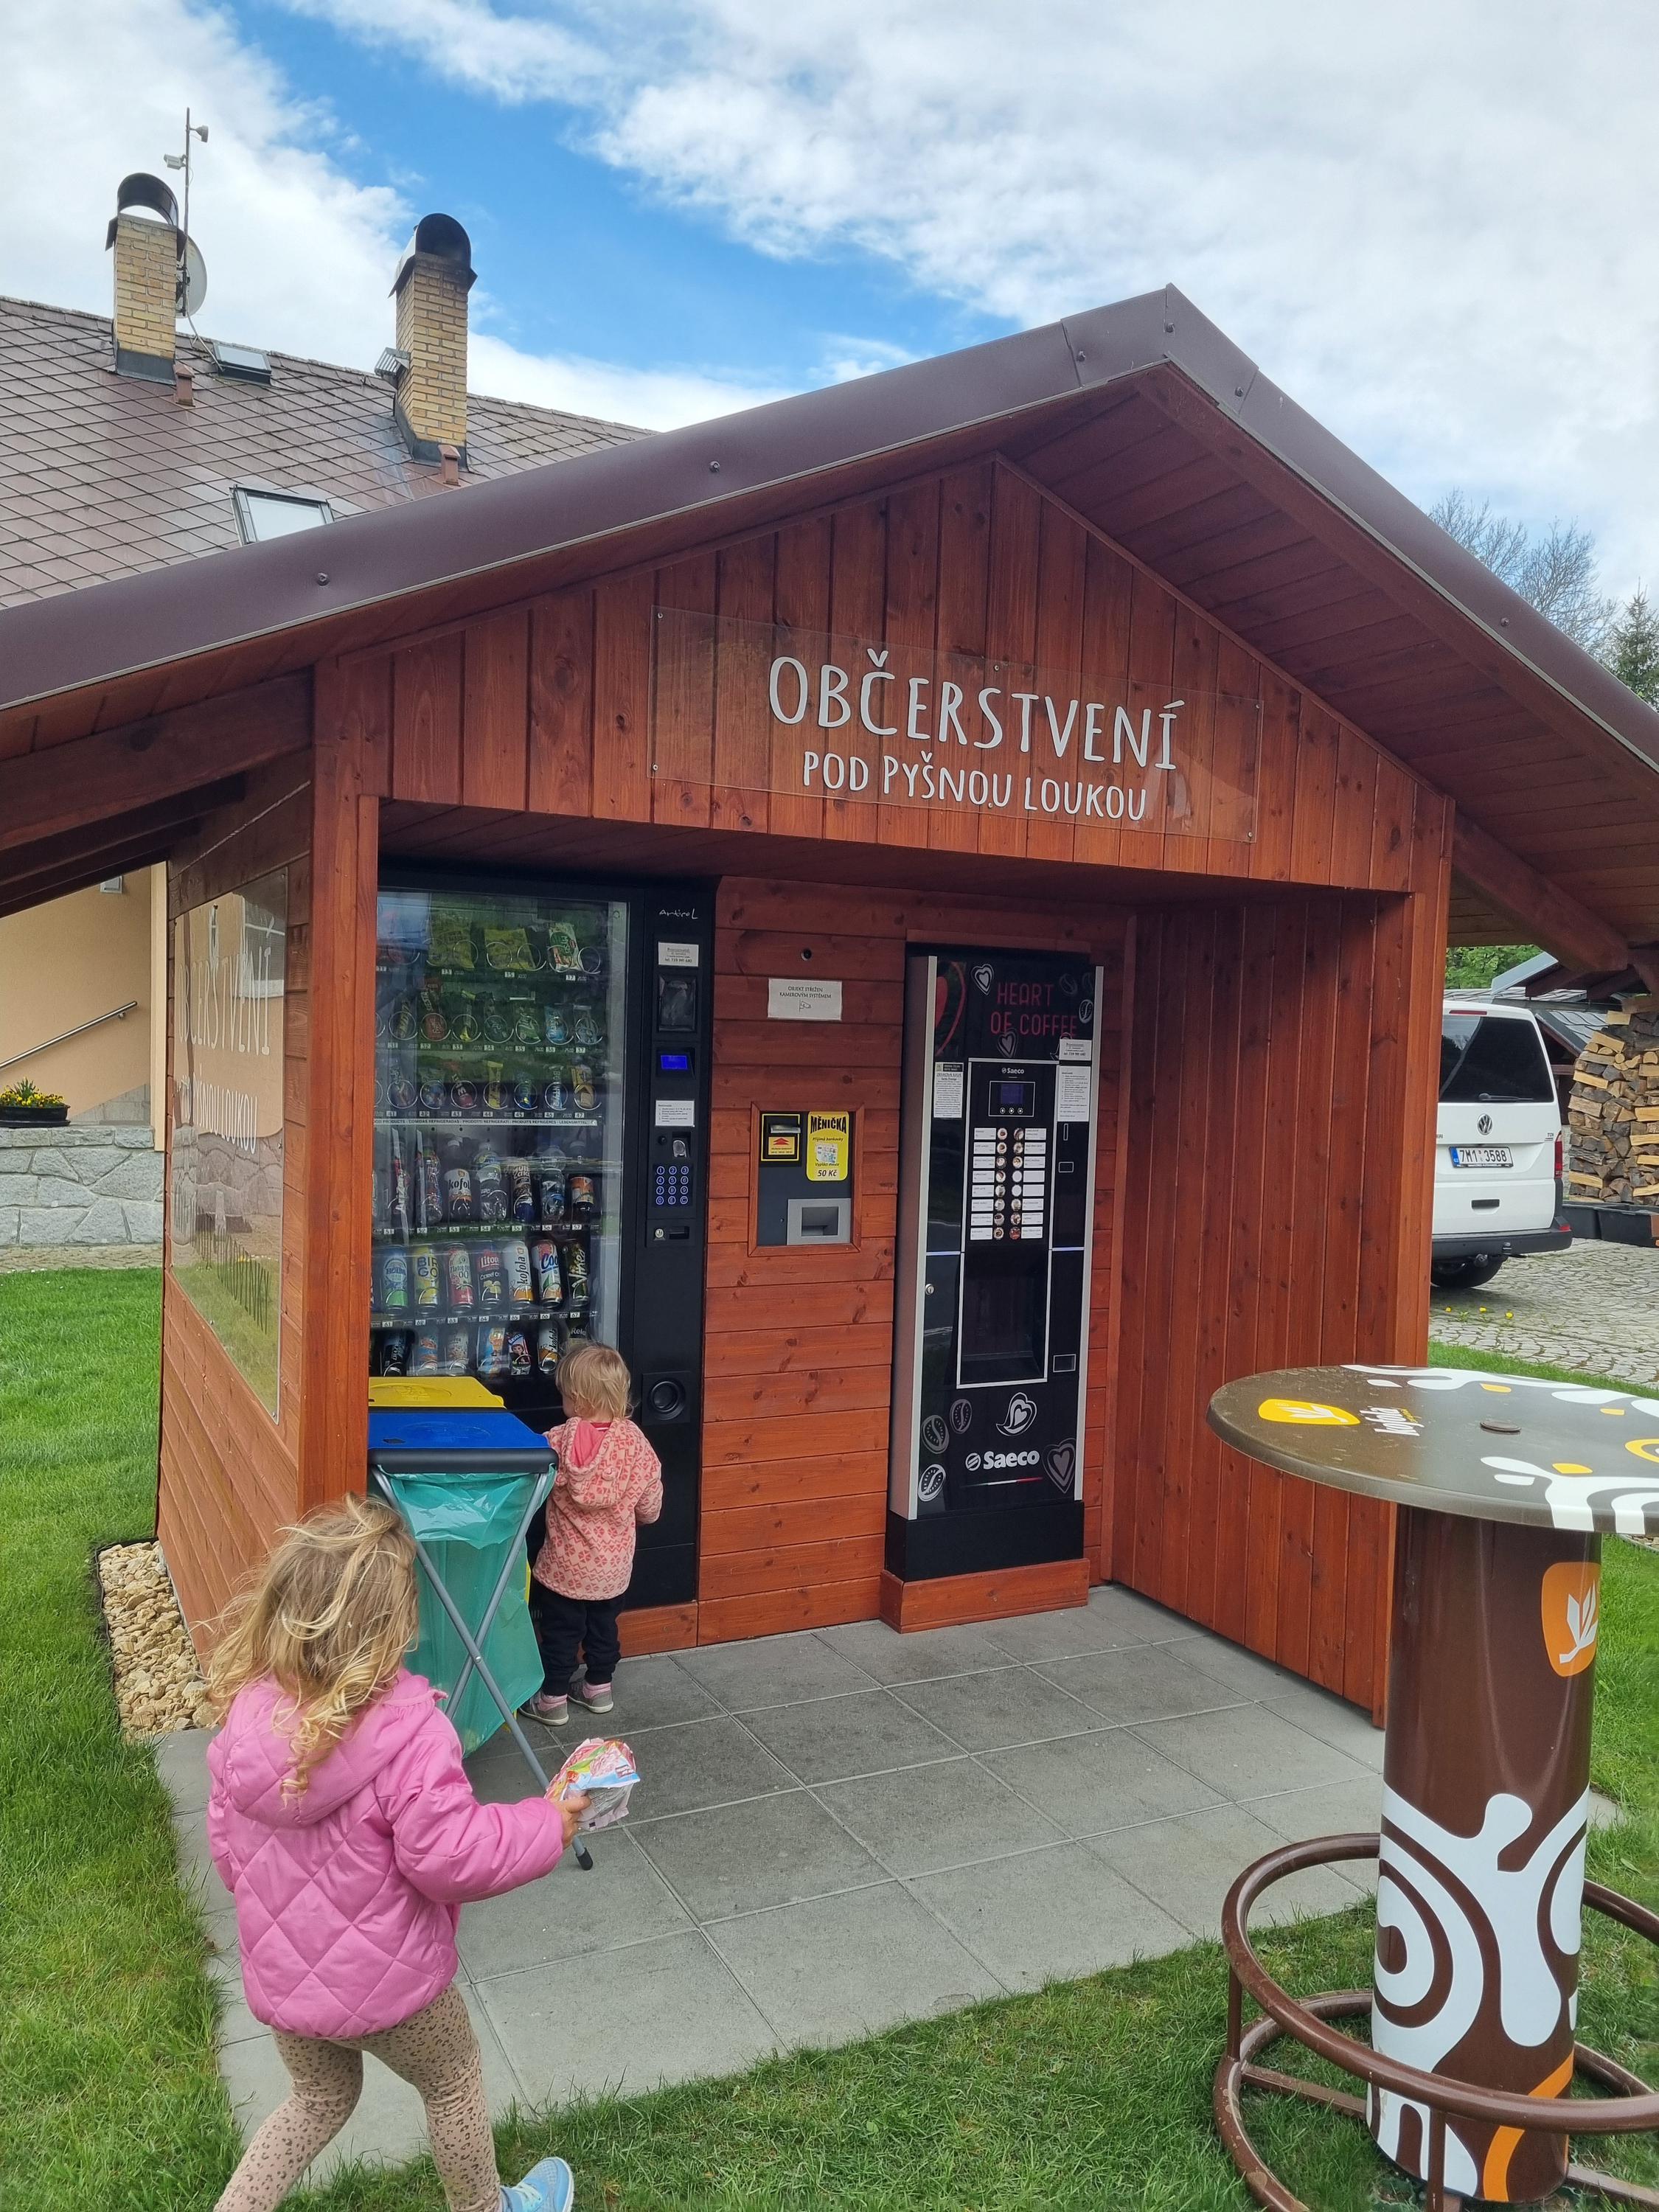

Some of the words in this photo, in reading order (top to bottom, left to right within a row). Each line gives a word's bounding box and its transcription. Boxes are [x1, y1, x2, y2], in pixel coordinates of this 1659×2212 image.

[768, 649, 1184, 771] OBČERSTVENÍ
[804, 751, 869, 792] POD
[883, 751, 1012, 808] PYŠNOU
[1023, 777, 1147, 822] LOUKOU
[997, 982, 1054, 1006] HEART
[991, 1011, 1012, 1034] OF
[1020, 1014, 1077, 1037] COFFEE
[221, 1086, 257, 1155] LOUKOU
[810, 1116, 846, 1134] MĚNIČKA
[1459, 1150, 1478, 1163] 7M1
[1484, 1150, 1507, 1162] 3588
[418, 1267, 439, 1279] GO
[515, 1256, 531, 1285] kofola
[983, 1450, 1040, 1470] Saeco
